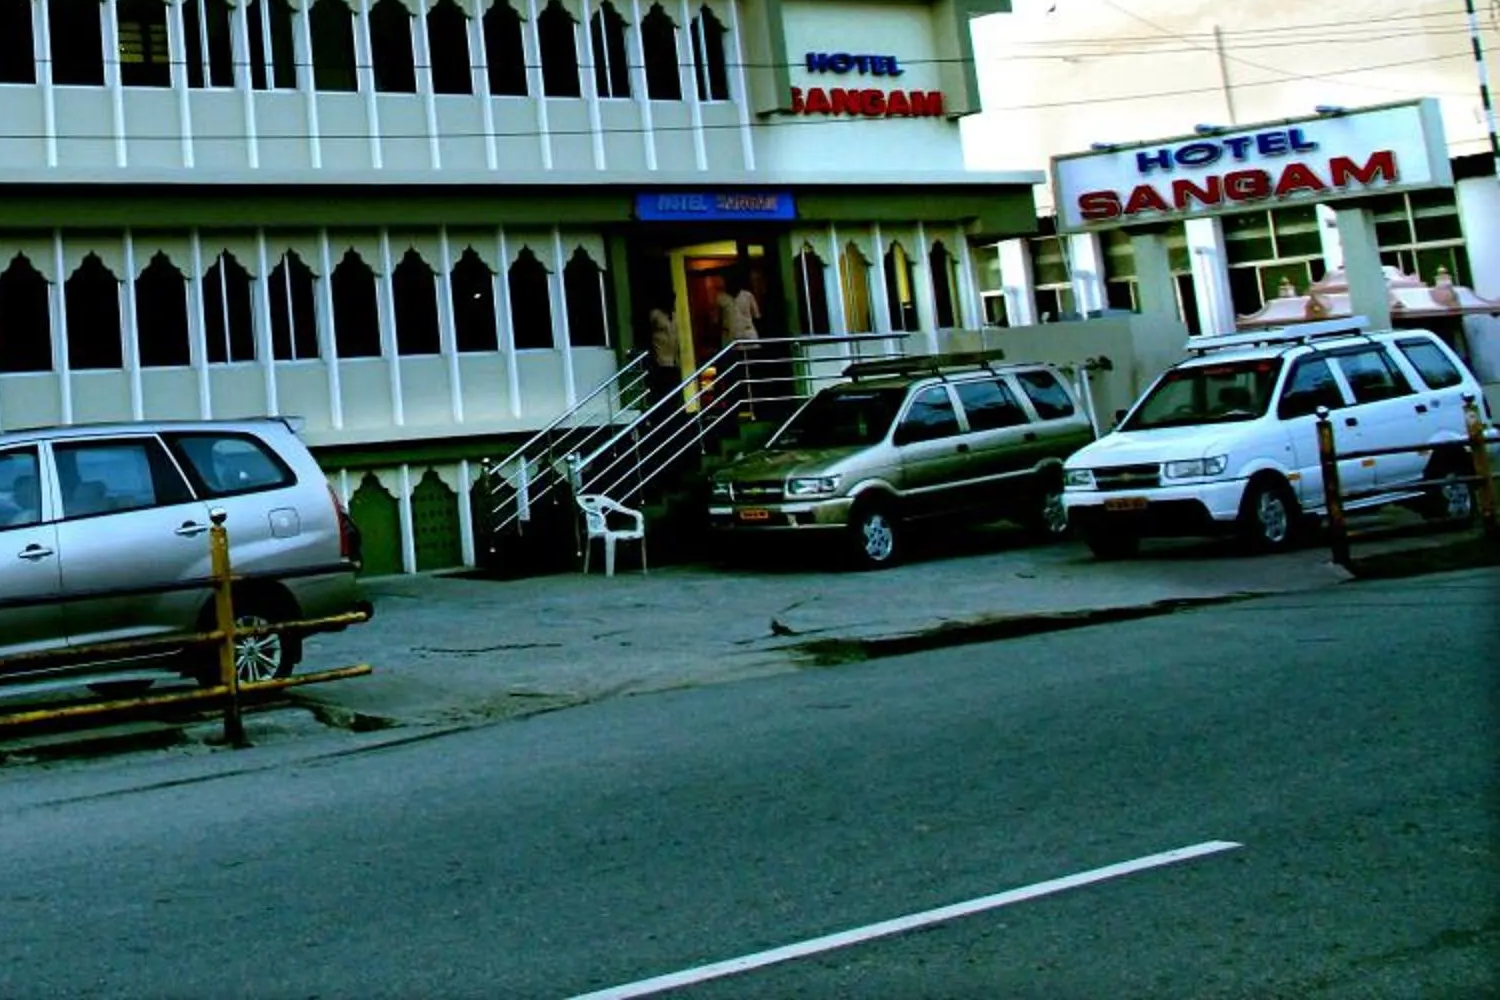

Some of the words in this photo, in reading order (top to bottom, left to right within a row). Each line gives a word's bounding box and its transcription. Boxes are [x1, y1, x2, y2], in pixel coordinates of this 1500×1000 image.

[805, 52, 904, 77] HOTEL
[1136, 127, 1318, 173] HOTEL
[1078, 150, 1398, 220] SANGAM
